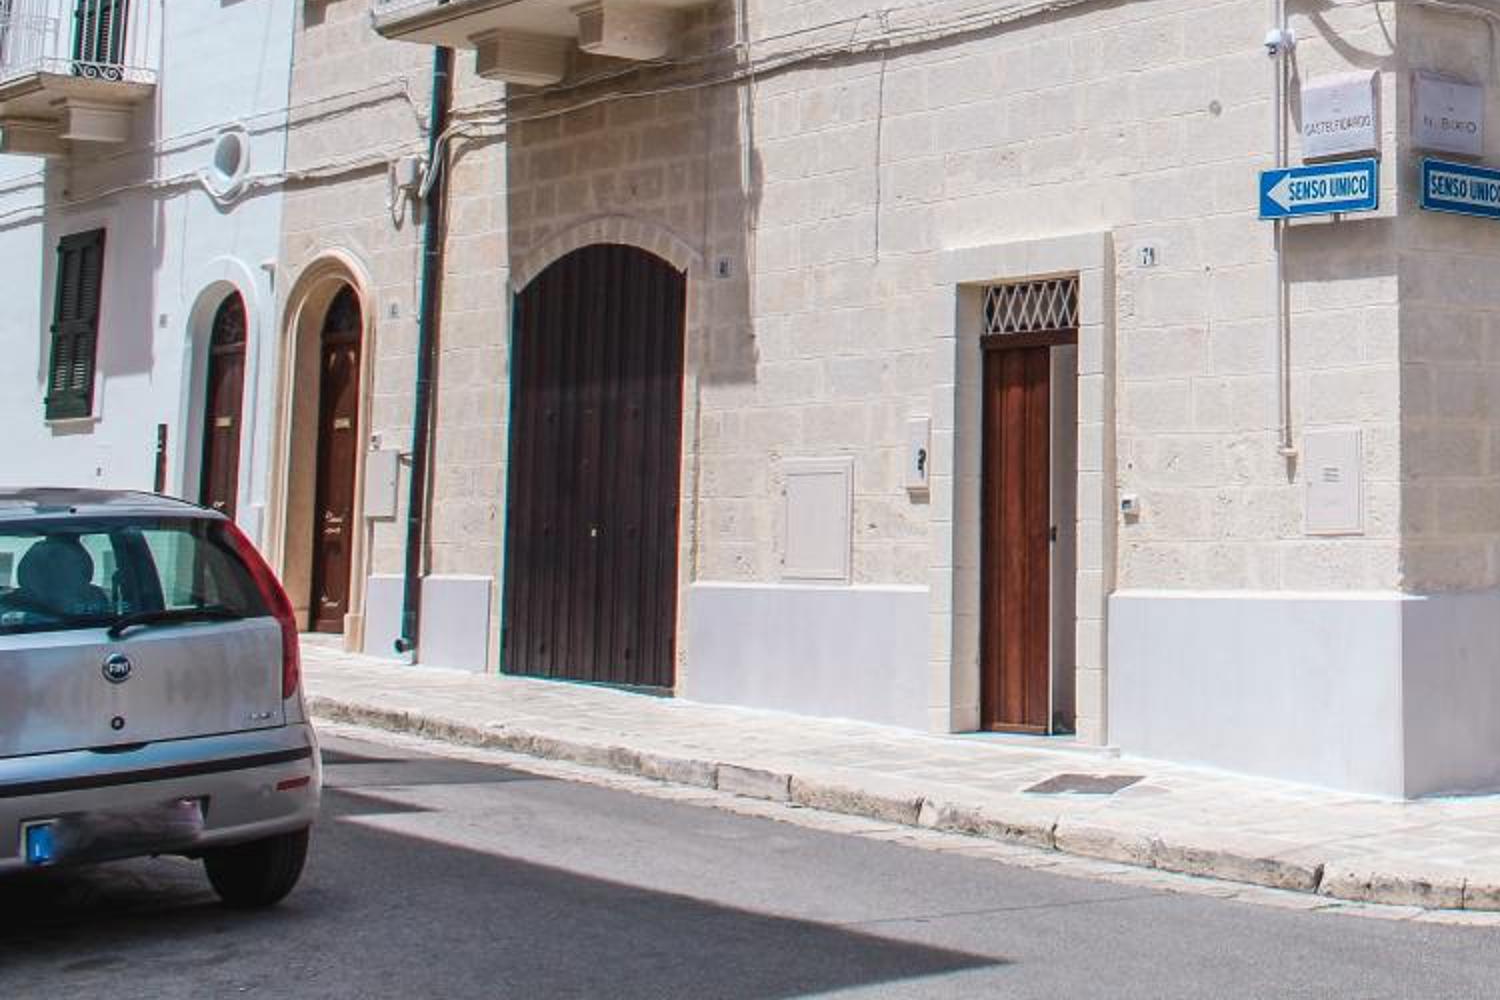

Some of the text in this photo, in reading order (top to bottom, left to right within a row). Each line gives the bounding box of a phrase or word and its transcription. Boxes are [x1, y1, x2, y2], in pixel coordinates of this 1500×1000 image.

[1288, 175, 1367, 201] SENSO UNICO
[1431, 175, 1467, 198] SENSO
